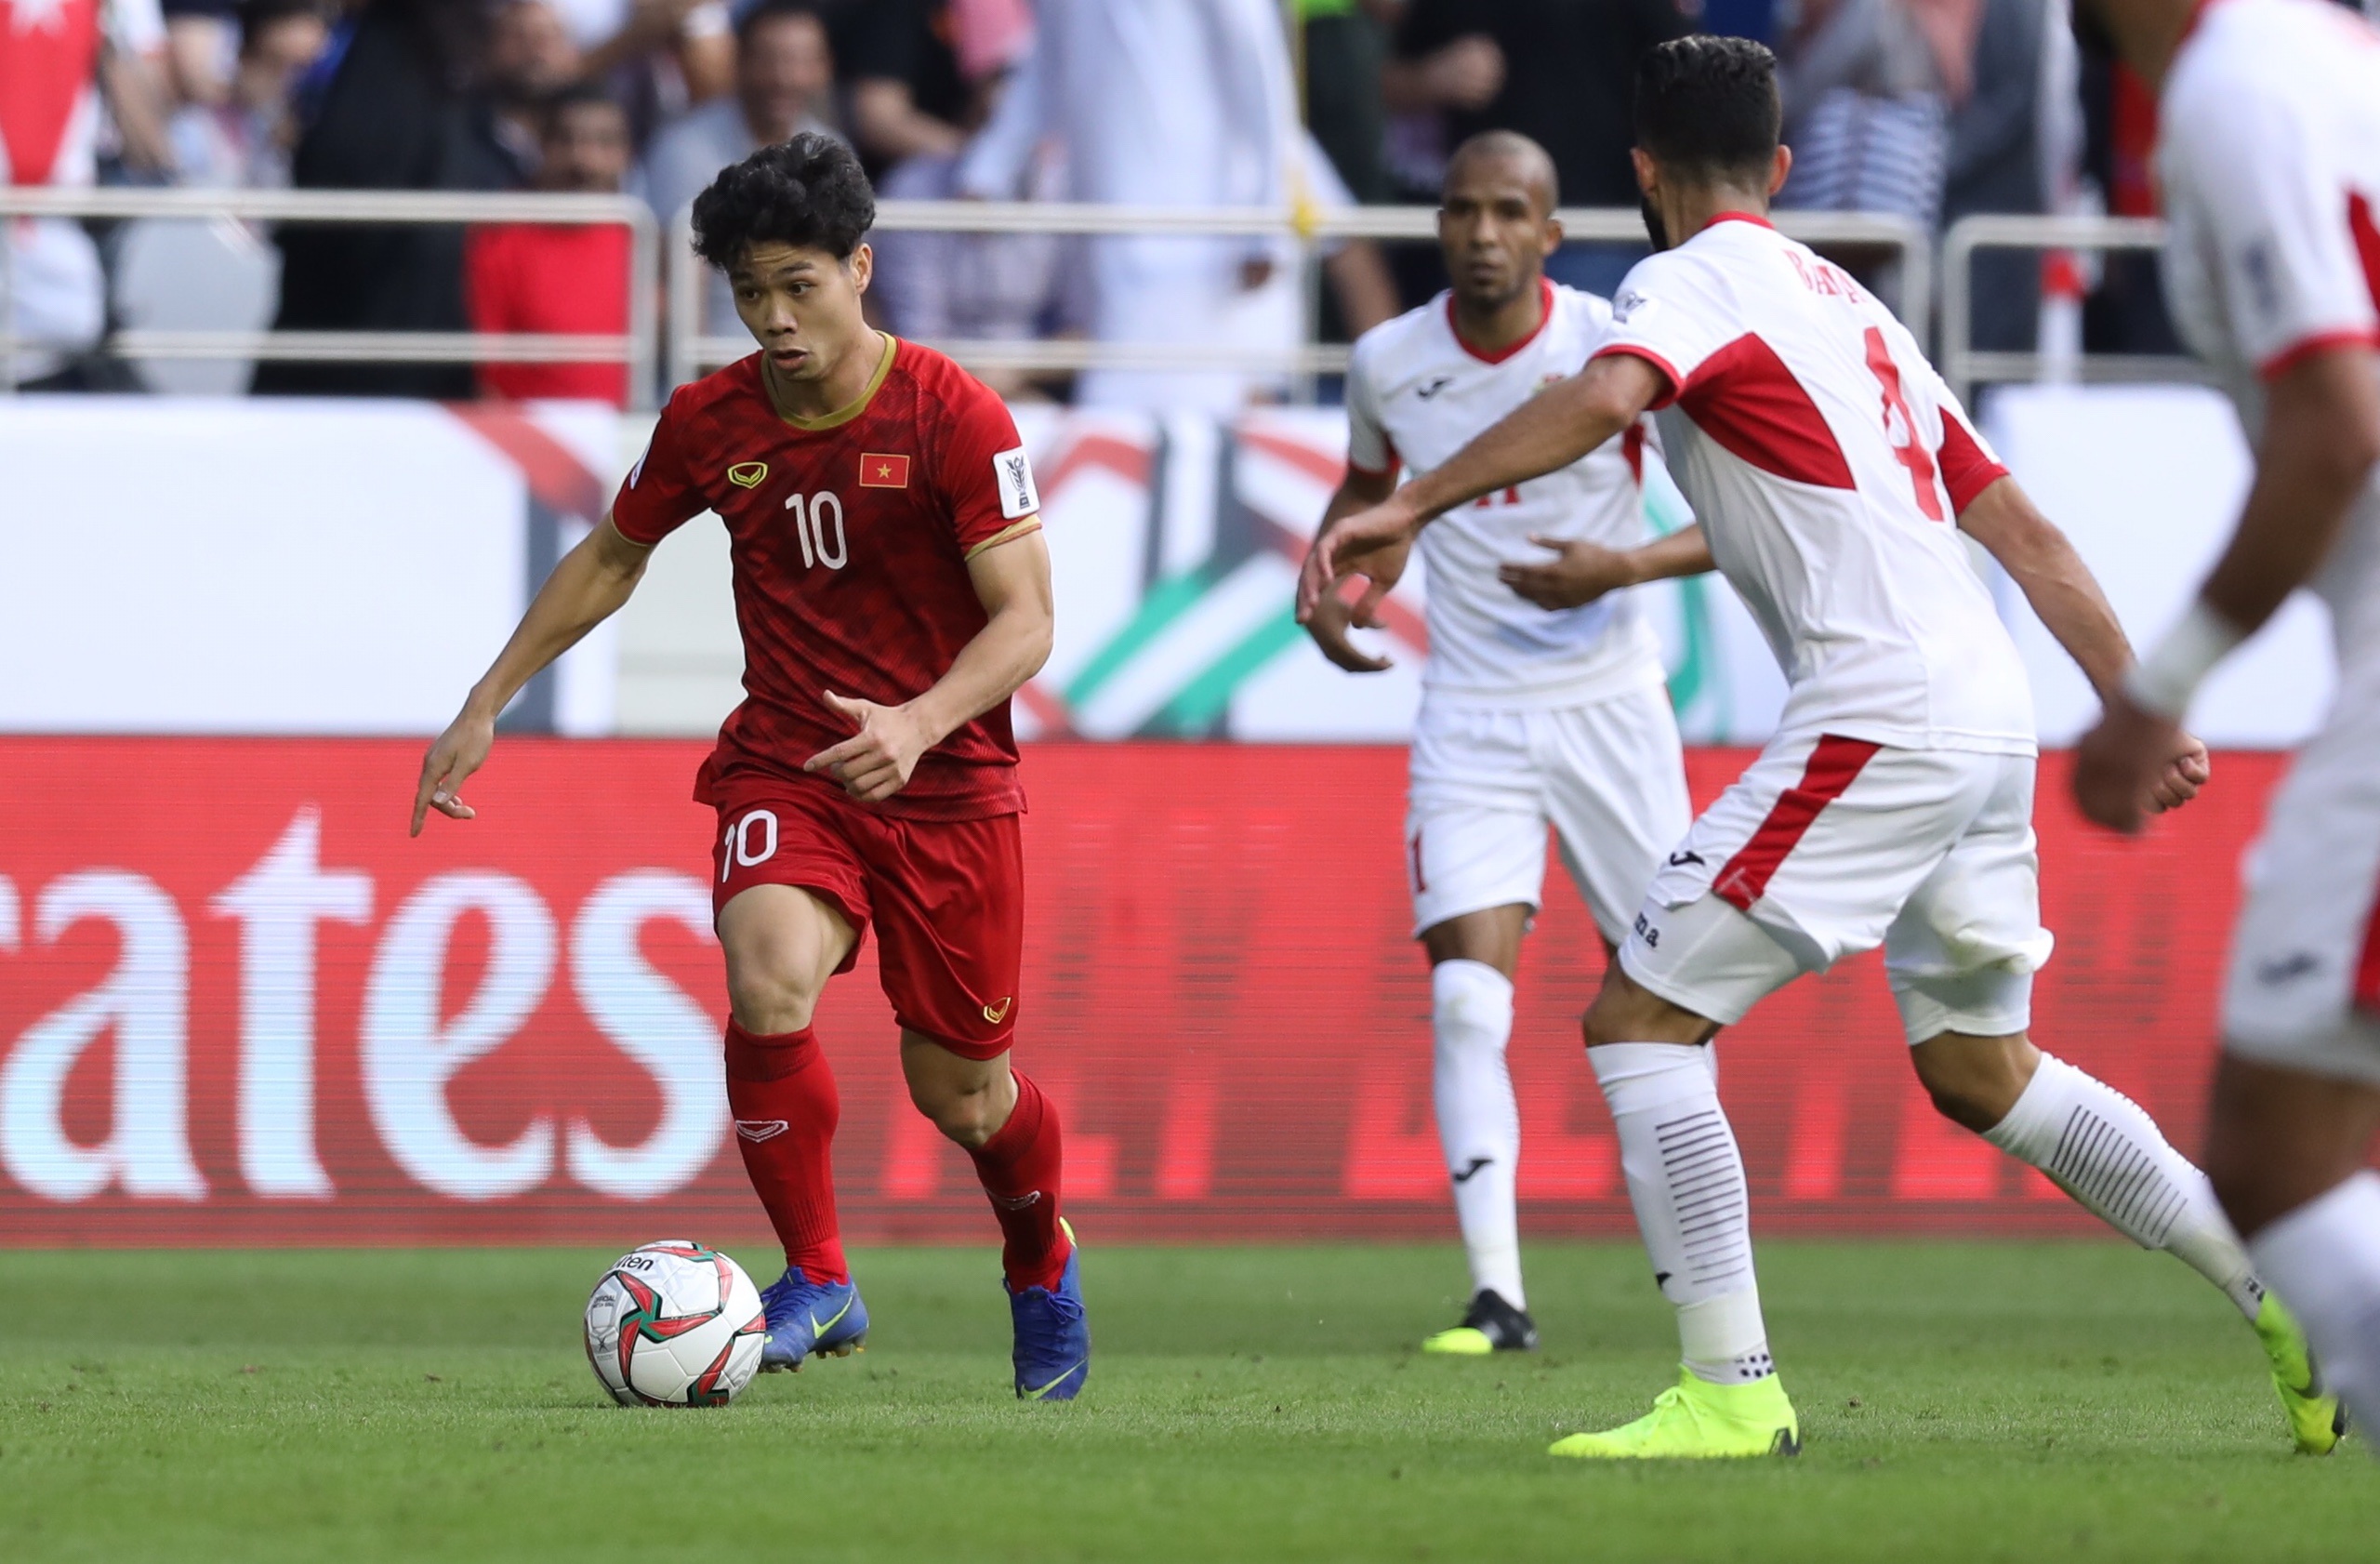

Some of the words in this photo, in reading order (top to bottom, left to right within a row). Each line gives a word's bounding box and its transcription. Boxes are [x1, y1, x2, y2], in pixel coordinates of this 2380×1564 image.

[785, 490, 848, 570] 10
[722, 809, 778, 882] 10
[0, 803, 730, 1201] ates
